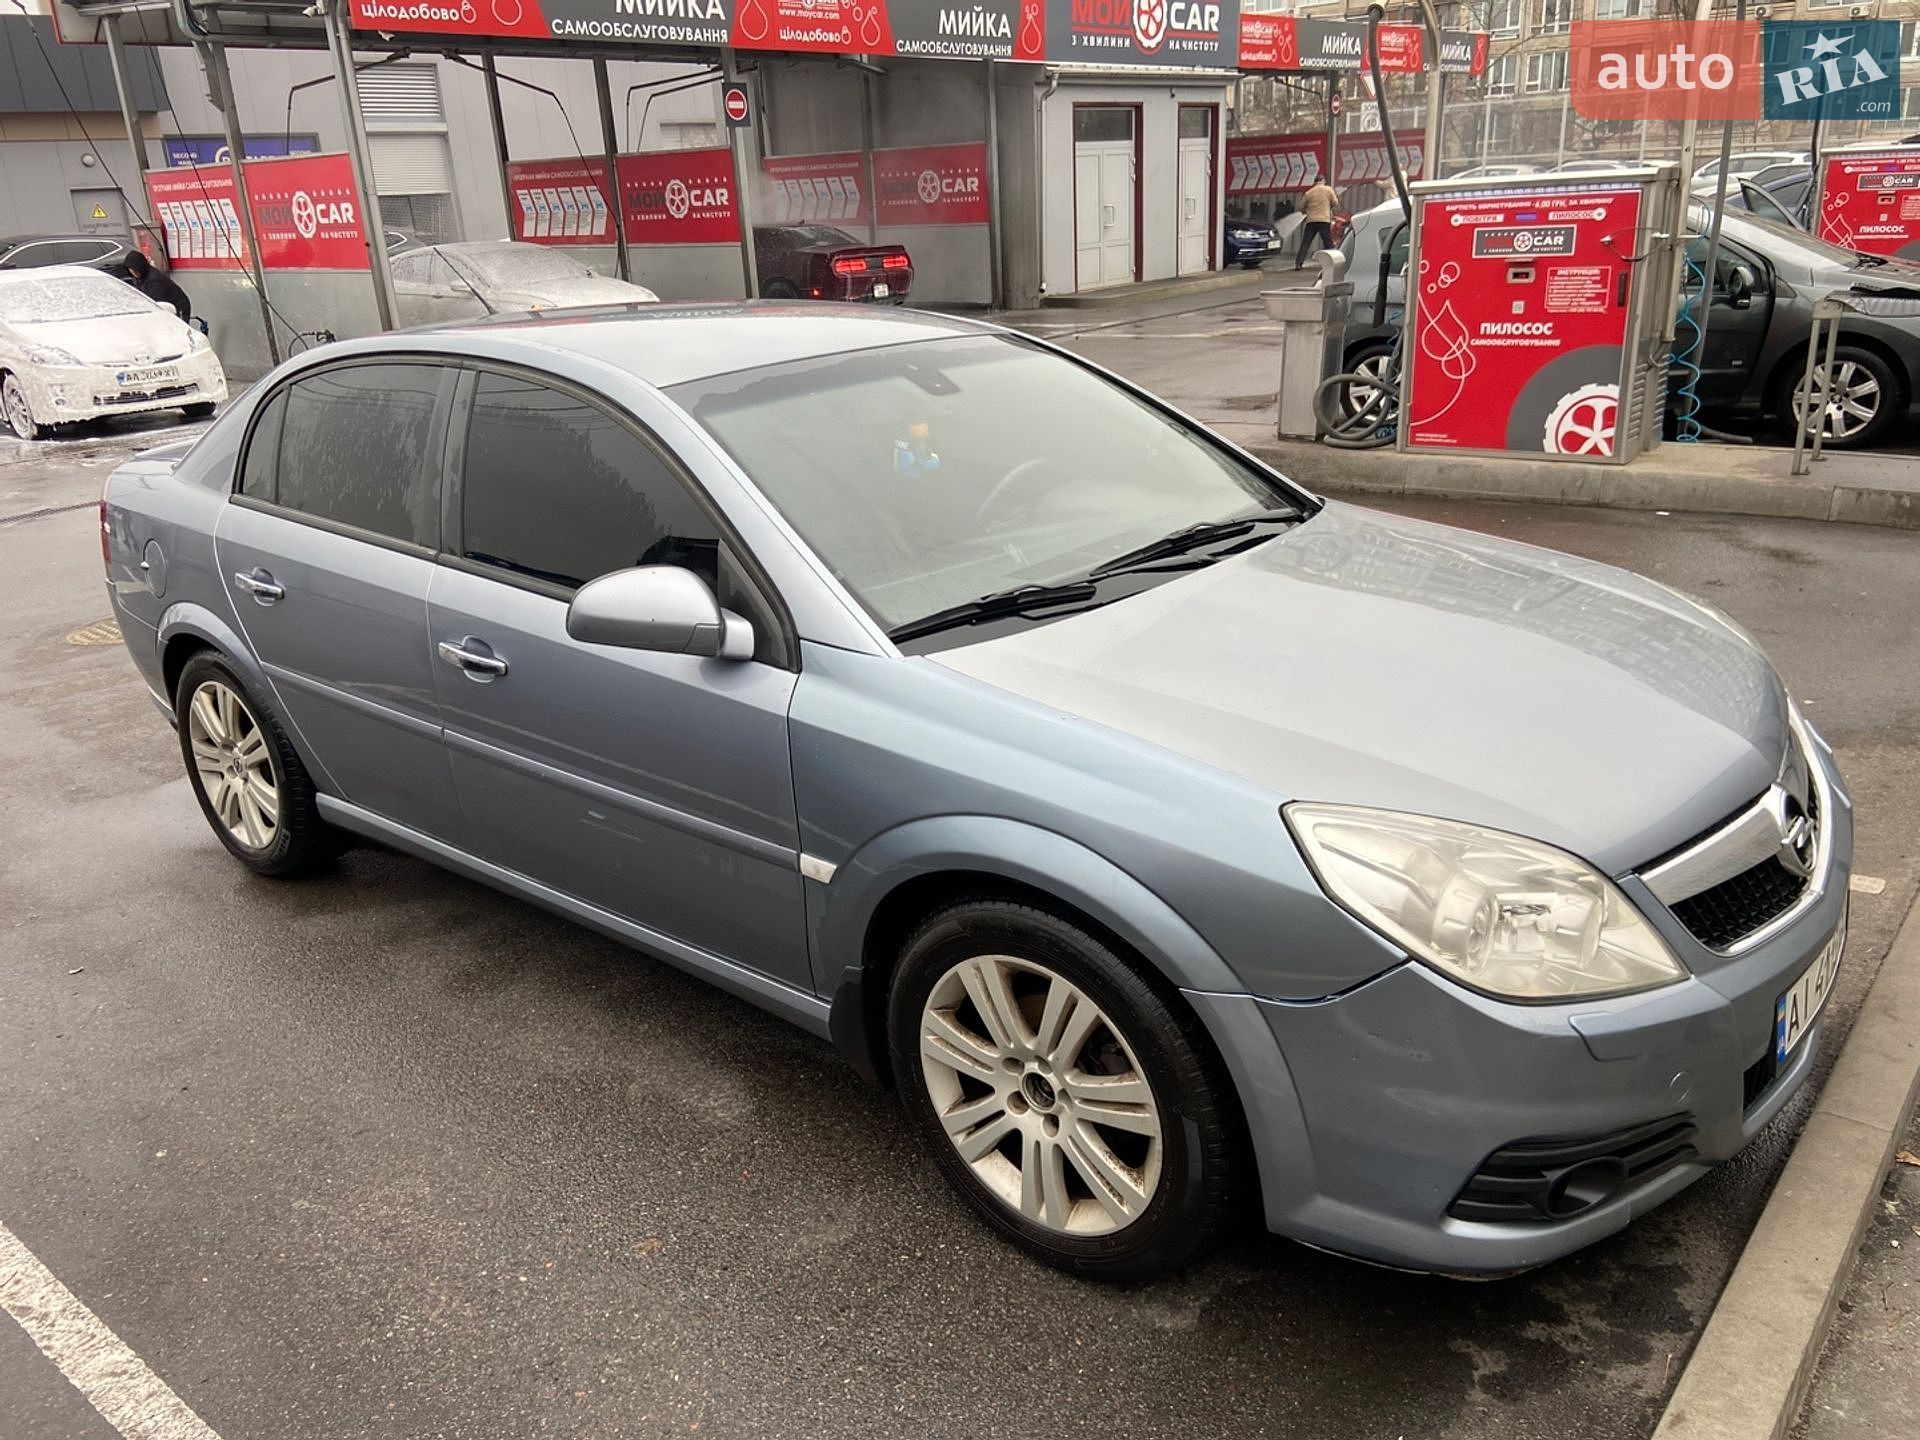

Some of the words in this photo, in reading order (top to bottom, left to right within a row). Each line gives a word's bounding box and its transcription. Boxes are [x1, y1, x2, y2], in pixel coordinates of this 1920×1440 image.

[361, 0, 459, 20] цілодобово
[1170, 2, 1221, 31] CAR
[551, 19, 728, 43] САМООБСЛУГОВУВАННЯ
[938, 6, 1012, 38] МИЙКА
[780, 26, 841, 43] цілодобово
[1322, 32, 1361, 54] МИЙКА
[895, 39, 1012, 57] САМООБСЛУГОВУВАННЯ
[1082, 36, 1131, 48] ХВИЛИНИ
[1169, 39, 1180, 50] НА
[1182, 40, 1220, 52] ЧИСТОТУ
[1440, 41, 1471, 61] МИЙКА
[941, 177, 979, 193] CAR
[690, 188, 729, 207] CAR
[316, 202, 355, 224] CAR
[1552, 211, 1594, 219] ПИЛОСОС
[1860, 225, 1905, 233] ПИЛОСОС
[1533, 235, 1564, 246] CAR
[1480, 322, 1553, 335] ПИЛОСОС
[1470, 339, 1561, 347] САМООБСЛУГОВУВАННЯ
